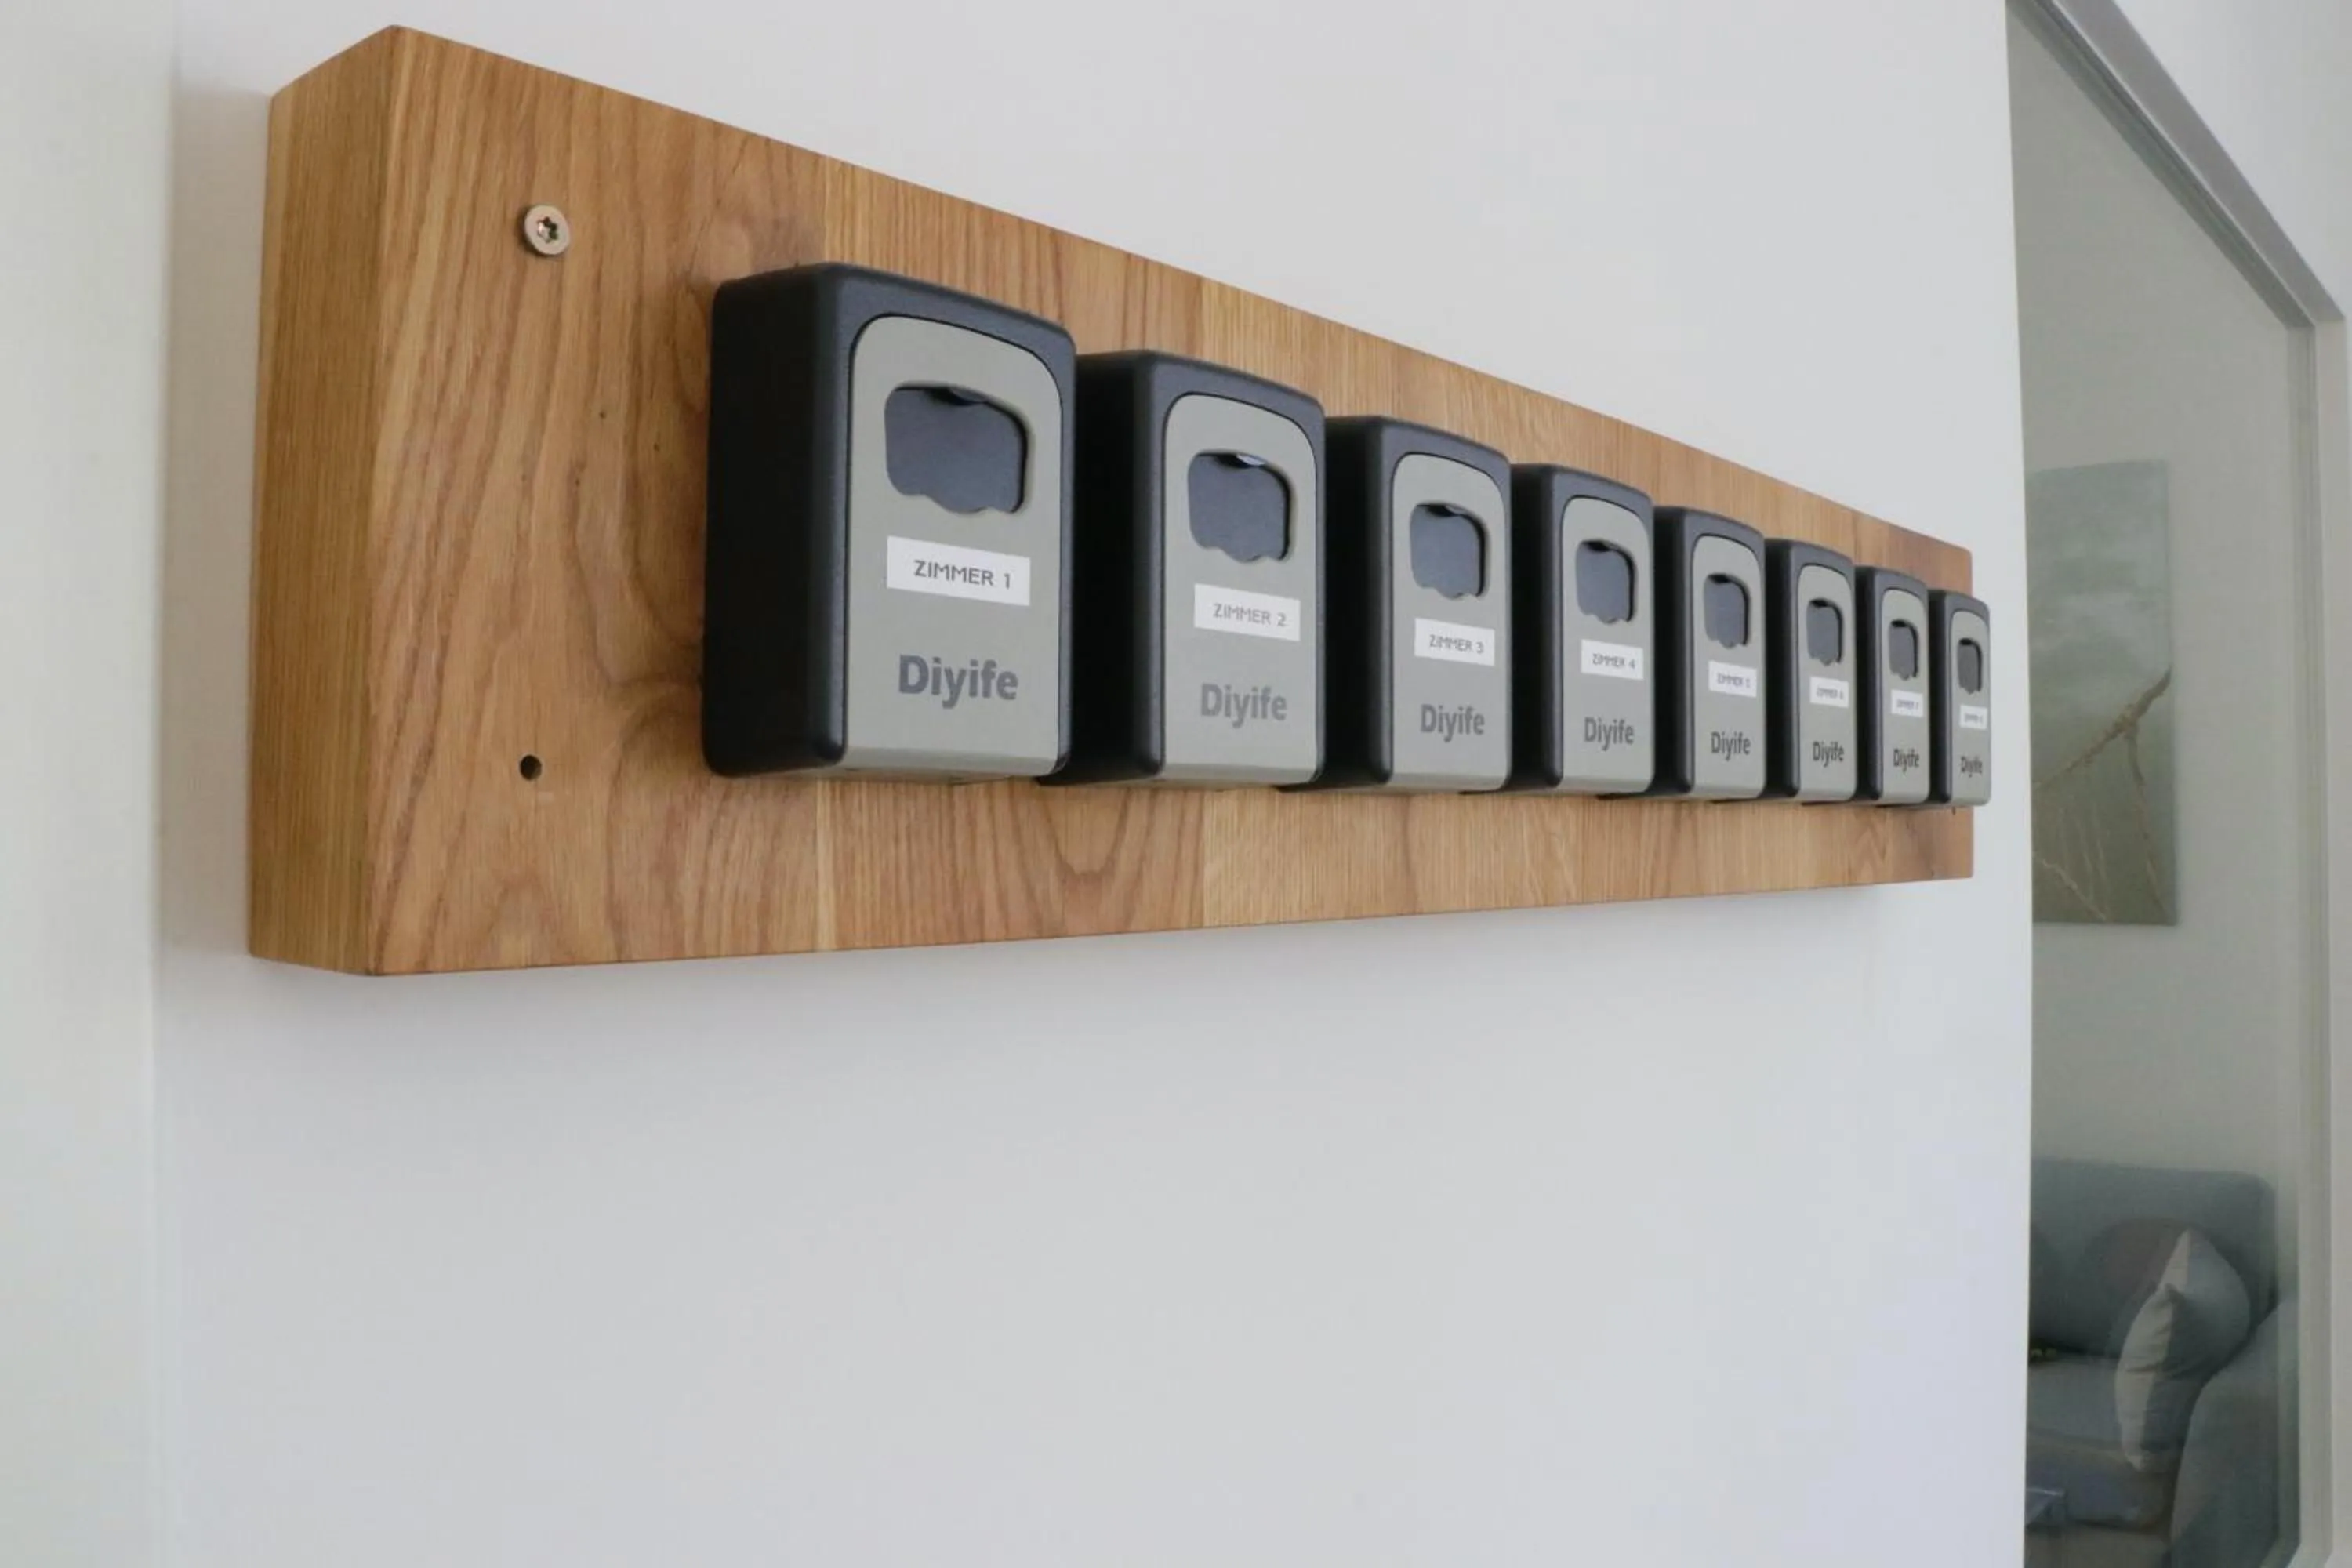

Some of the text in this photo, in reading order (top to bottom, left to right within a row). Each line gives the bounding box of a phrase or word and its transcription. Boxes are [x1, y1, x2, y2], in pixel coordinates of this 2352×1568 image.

[913, 559, 1011, 590] ZIMMER 1
[1213, 603, 1287, 627] ZIMMER 2
[1429, 633, 1484, 654] ZIMMER 3
[898, 654, 1019, 710] Diyife
[1200, 682, 1288, 729] Diyife
[1420, 703, 1486, 743] Diyife
[1584, 715, 1635, 752] Diyife
[1711, 731, 1751, 762] Diyife
[1813, 740, 1844, 768] Diyife
